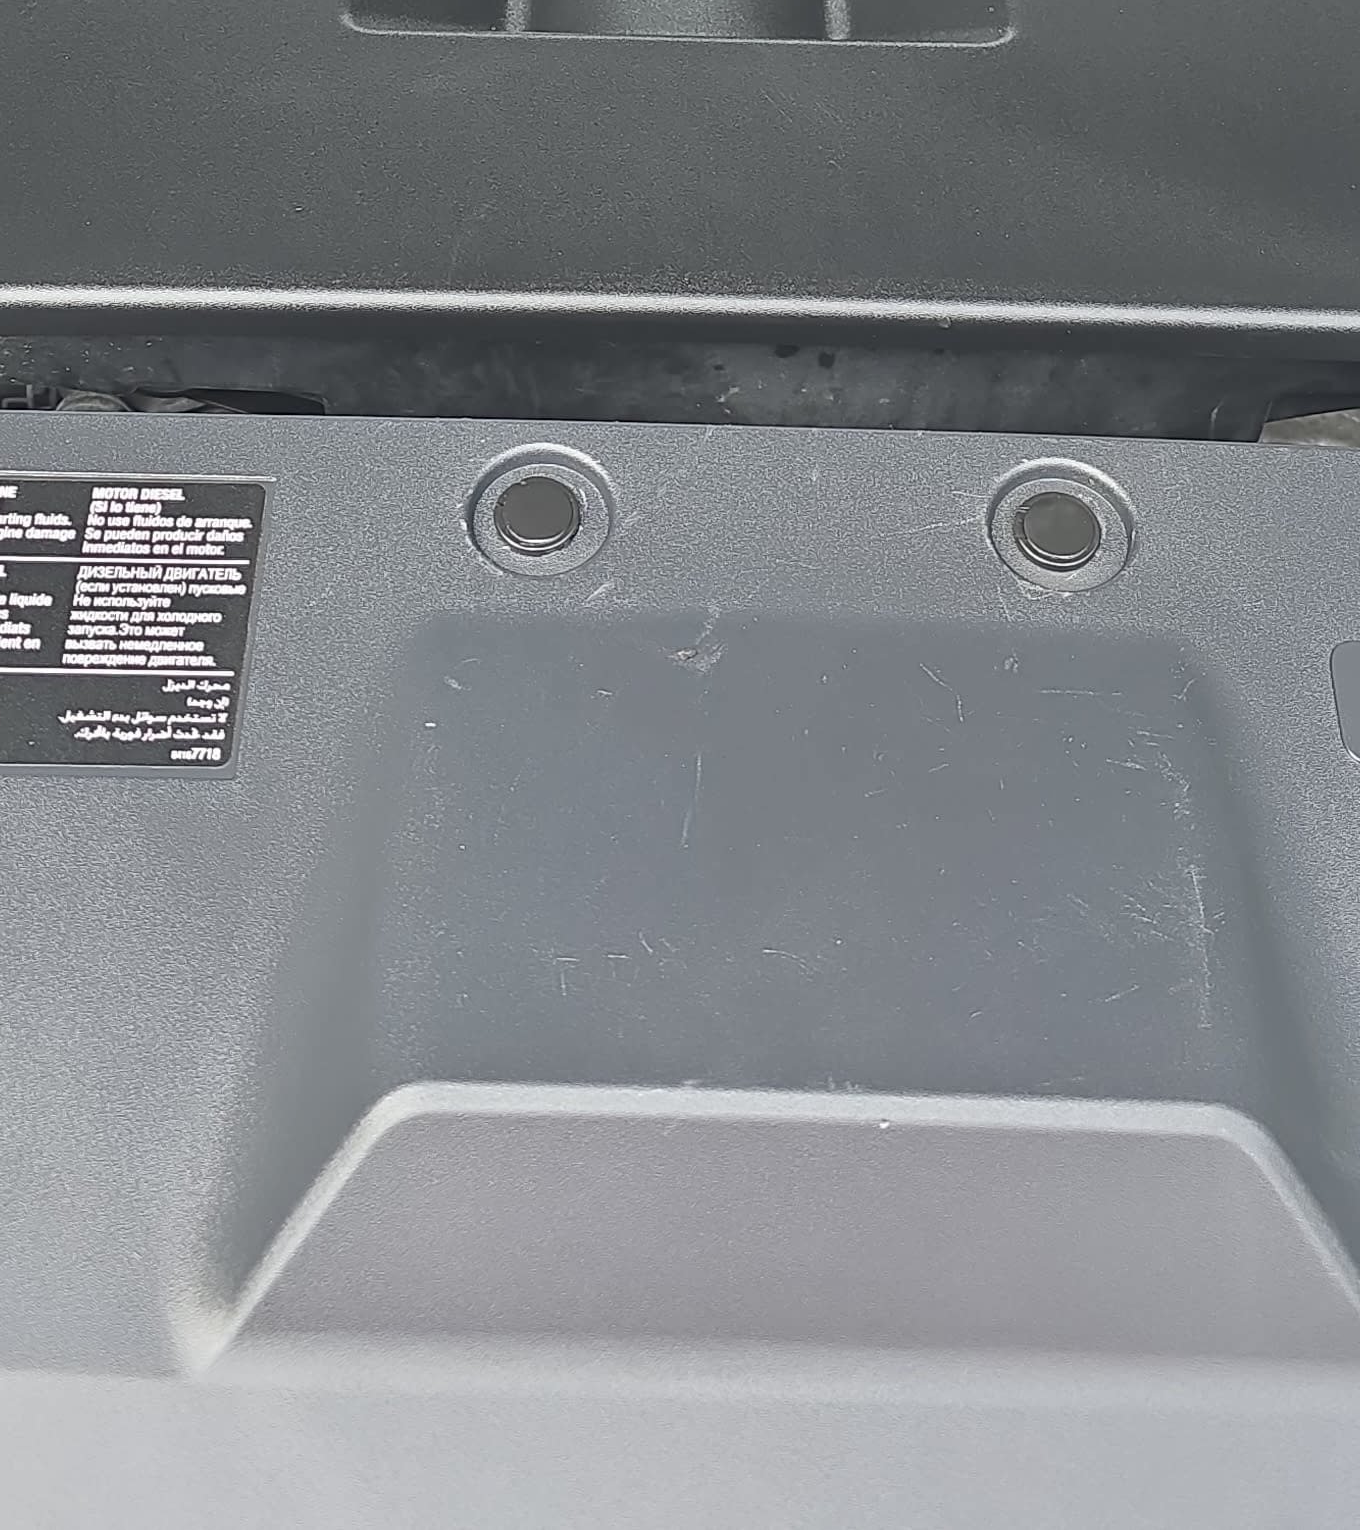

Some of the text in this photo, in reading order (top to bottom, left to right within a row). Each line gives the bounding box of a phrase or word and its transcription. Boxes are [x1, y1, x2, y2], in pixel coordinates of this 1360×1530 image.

[92, 487, 185, 501] MOTOR DIESEL
[110, 502, 123, 513] lo
[126, 502, 162, 515] tiene)
[34, 513, 72, 526] fluids.
[87, 515, 253, 530] No use fluidos de arranque.
[25, 527, 76, 542] damage
[84, 528, 244, 542] Se pueden producir daños
[152, 544, 169, 554] en
[171, 543, 183, 555] el
[186, 544, 225, 556] motor.
[77, 565, 242, 582] ДИЗЕЛЬНЫЙ ДВИГАТЕЛЬ
[75, 580, 110, 594] (если
[112, 582, 186, 596] установлен)
[9, 593, 53, 608] liquide
[73, 595, 171, 610] Не используйте
[130, 611, 155, 623] для
[156, 612, 222, 625] холодного
[23, 638, 41, 650] en
